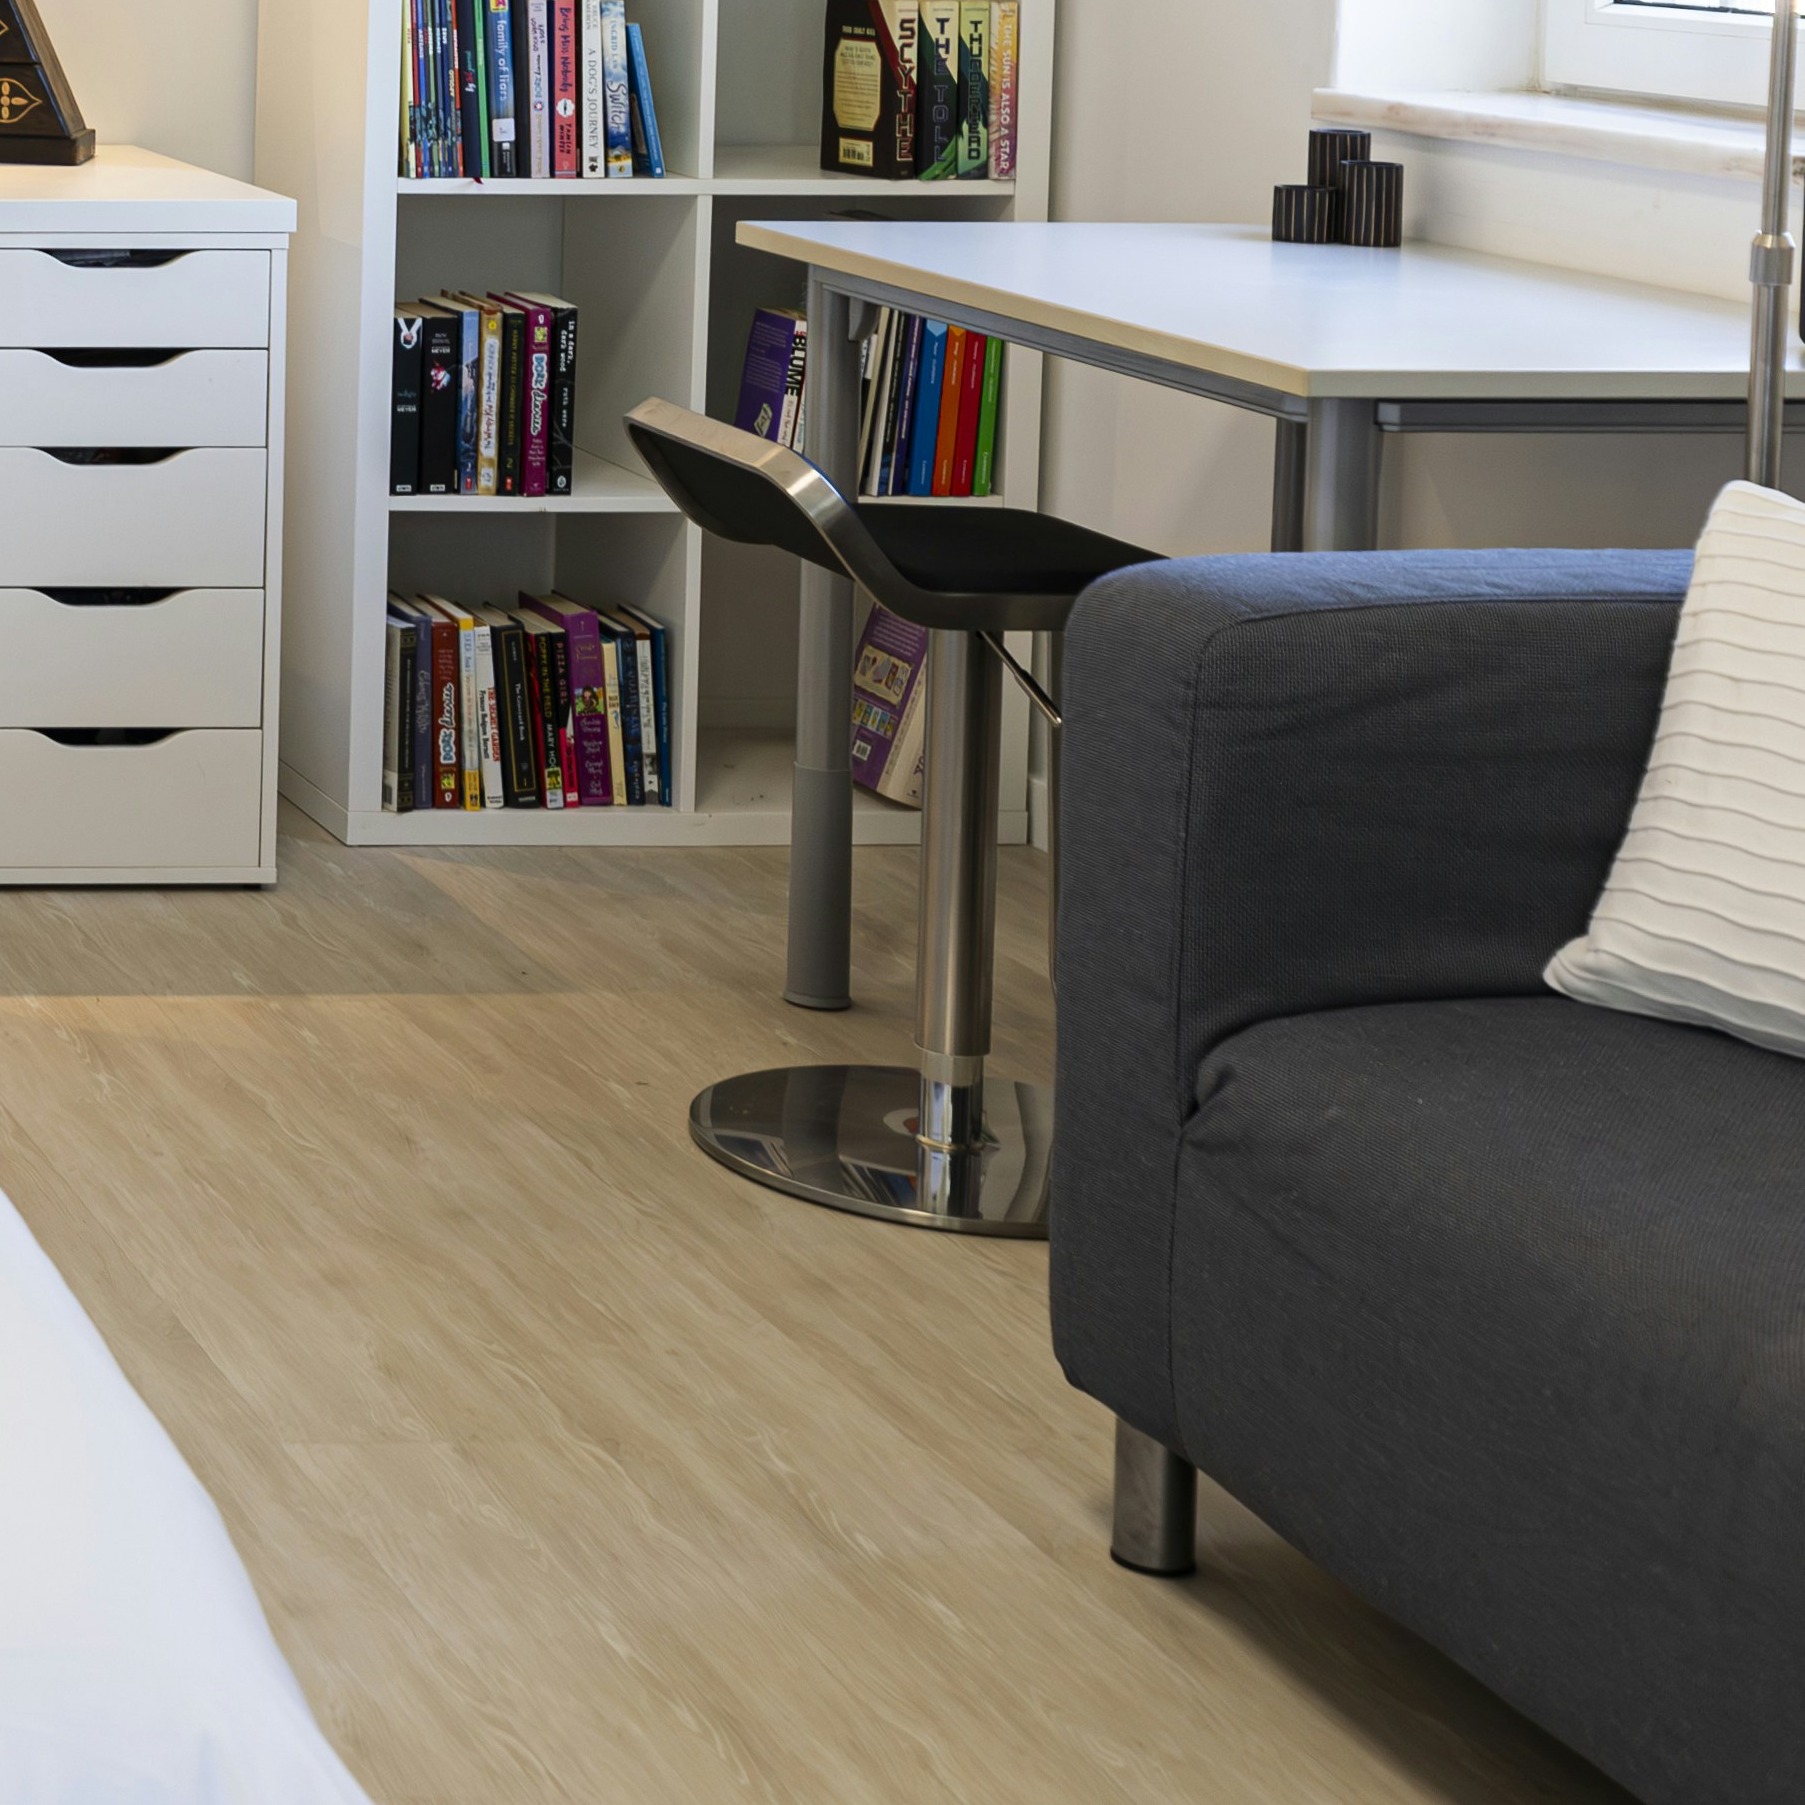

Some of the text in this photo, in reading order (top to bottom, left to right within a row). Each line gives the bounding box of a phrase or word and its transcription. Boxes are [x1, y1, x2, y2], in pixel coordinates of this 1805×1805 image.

[610, 19, 619, 51] INGRID
[494, 19, 510, 101] family of liars
[587, 59, 598, 95] DOG'S
[1002, 49, 1012, 76] SUN
[605, 81, 627, 131] Switch
[896, 17, 917, 161] SCYTHE
[932, 17, 951, 163] THE TOLL
[587, 97, 599, 149] JOURNEY
[1000, 93, 1010, 123] ALSO
[999, 138, 1010, 169] STAR
[560, 329, 568, 349] dark
[568, 320, 575, 331] in
[533, 355, 546, 388] DORK
[556, 642, 567, 705] PIZZA GIRL
[488, 687, 500, 762] THE SECRET GARDEN
[545, 723, 554, 747] MARY
